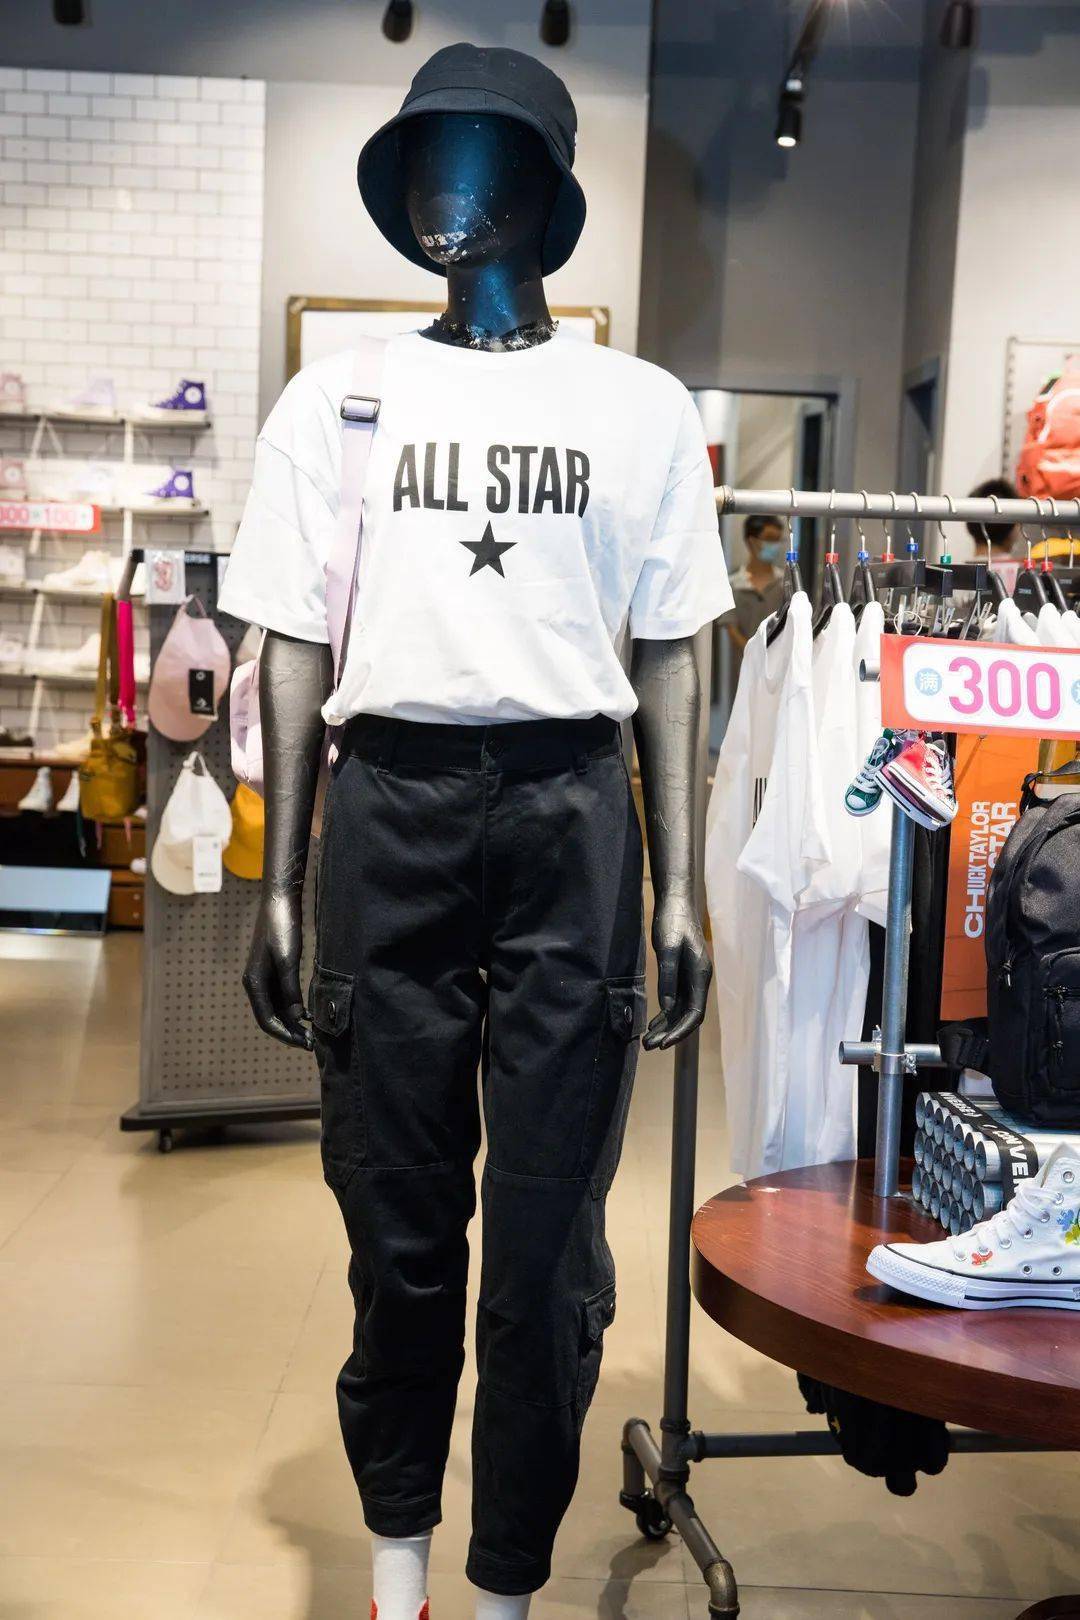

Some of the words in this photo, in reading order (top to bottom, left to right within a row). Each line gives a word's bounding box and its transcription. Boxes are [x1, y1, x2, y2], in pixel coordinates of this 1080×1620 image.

[393, 442, 469, 513] ALL
[486, 443, 591, 519] STAR
[919, 670, 939, 692] 满
[948, 656, 1061, 720] 300
[968, 800, 991, 863] TAYLOR
[964, 864, 988, 939] CHUCK
